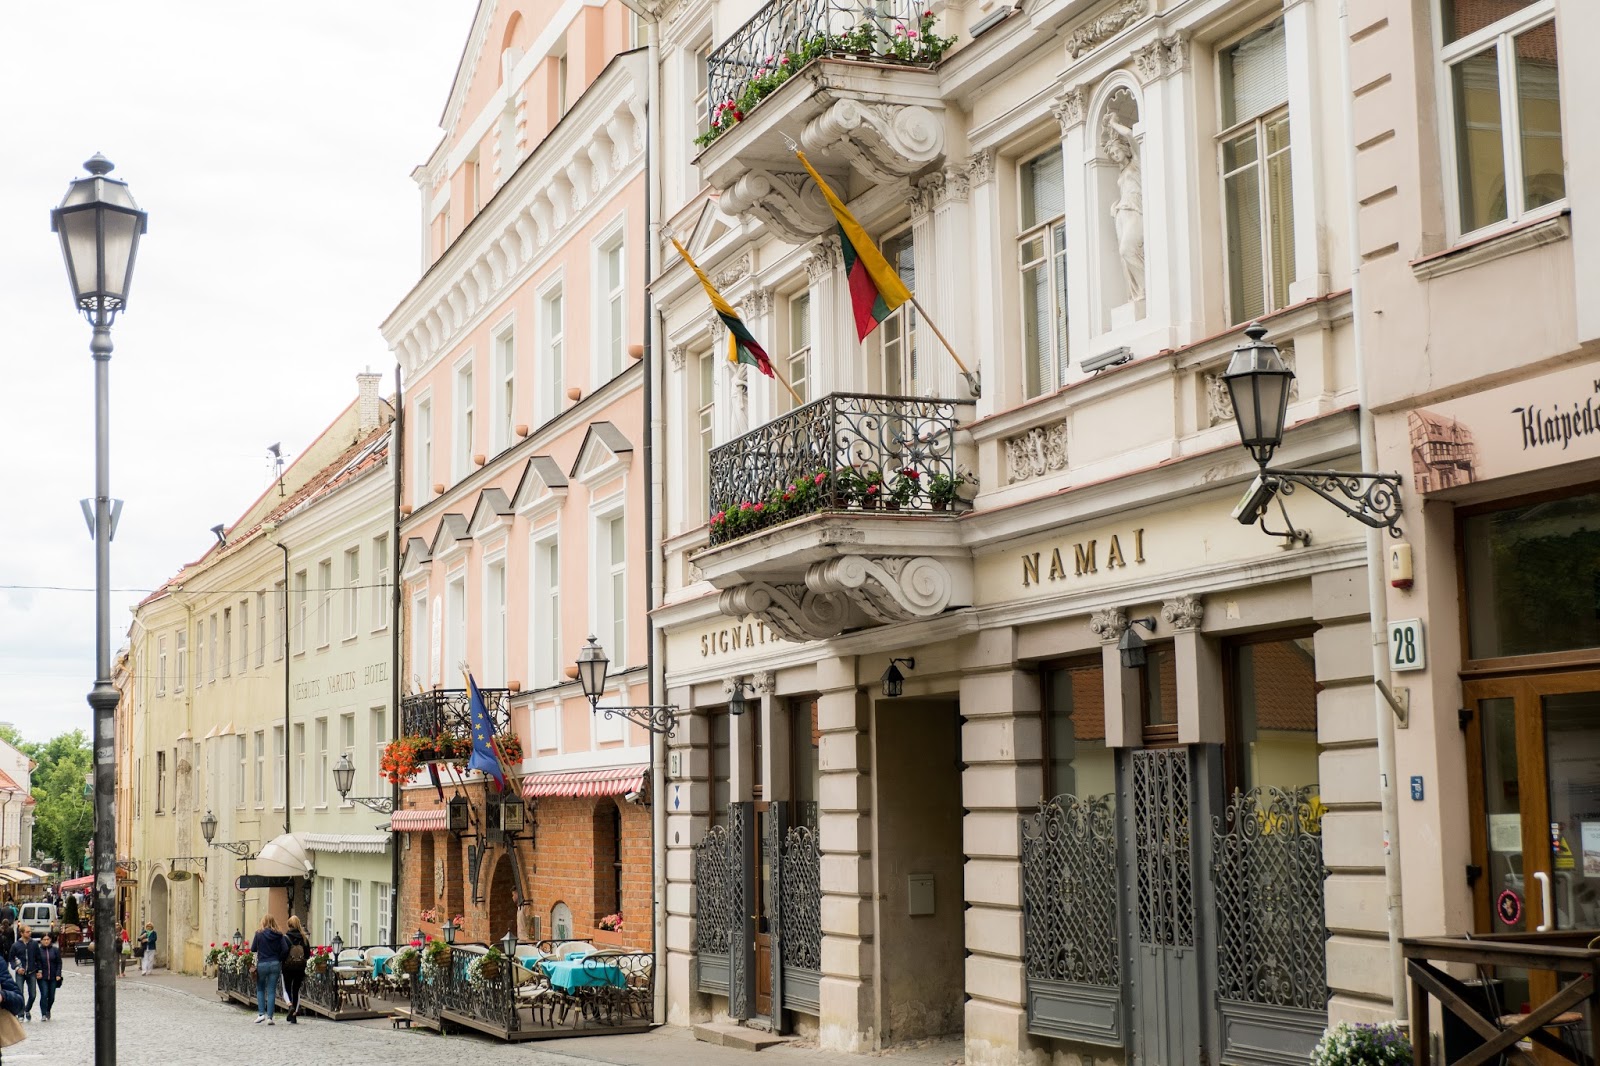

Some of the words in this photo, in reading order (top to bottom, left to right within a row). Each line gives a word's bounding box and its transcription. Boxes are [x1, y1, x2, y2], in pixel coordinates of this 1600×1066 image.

[1021, 528, 1145, 587] NAMAI
[1394, 626, 1416, 665] 28
[327, 671, 356, 695] NARUTIS
[364, 662, 388, 686] HOTEL
